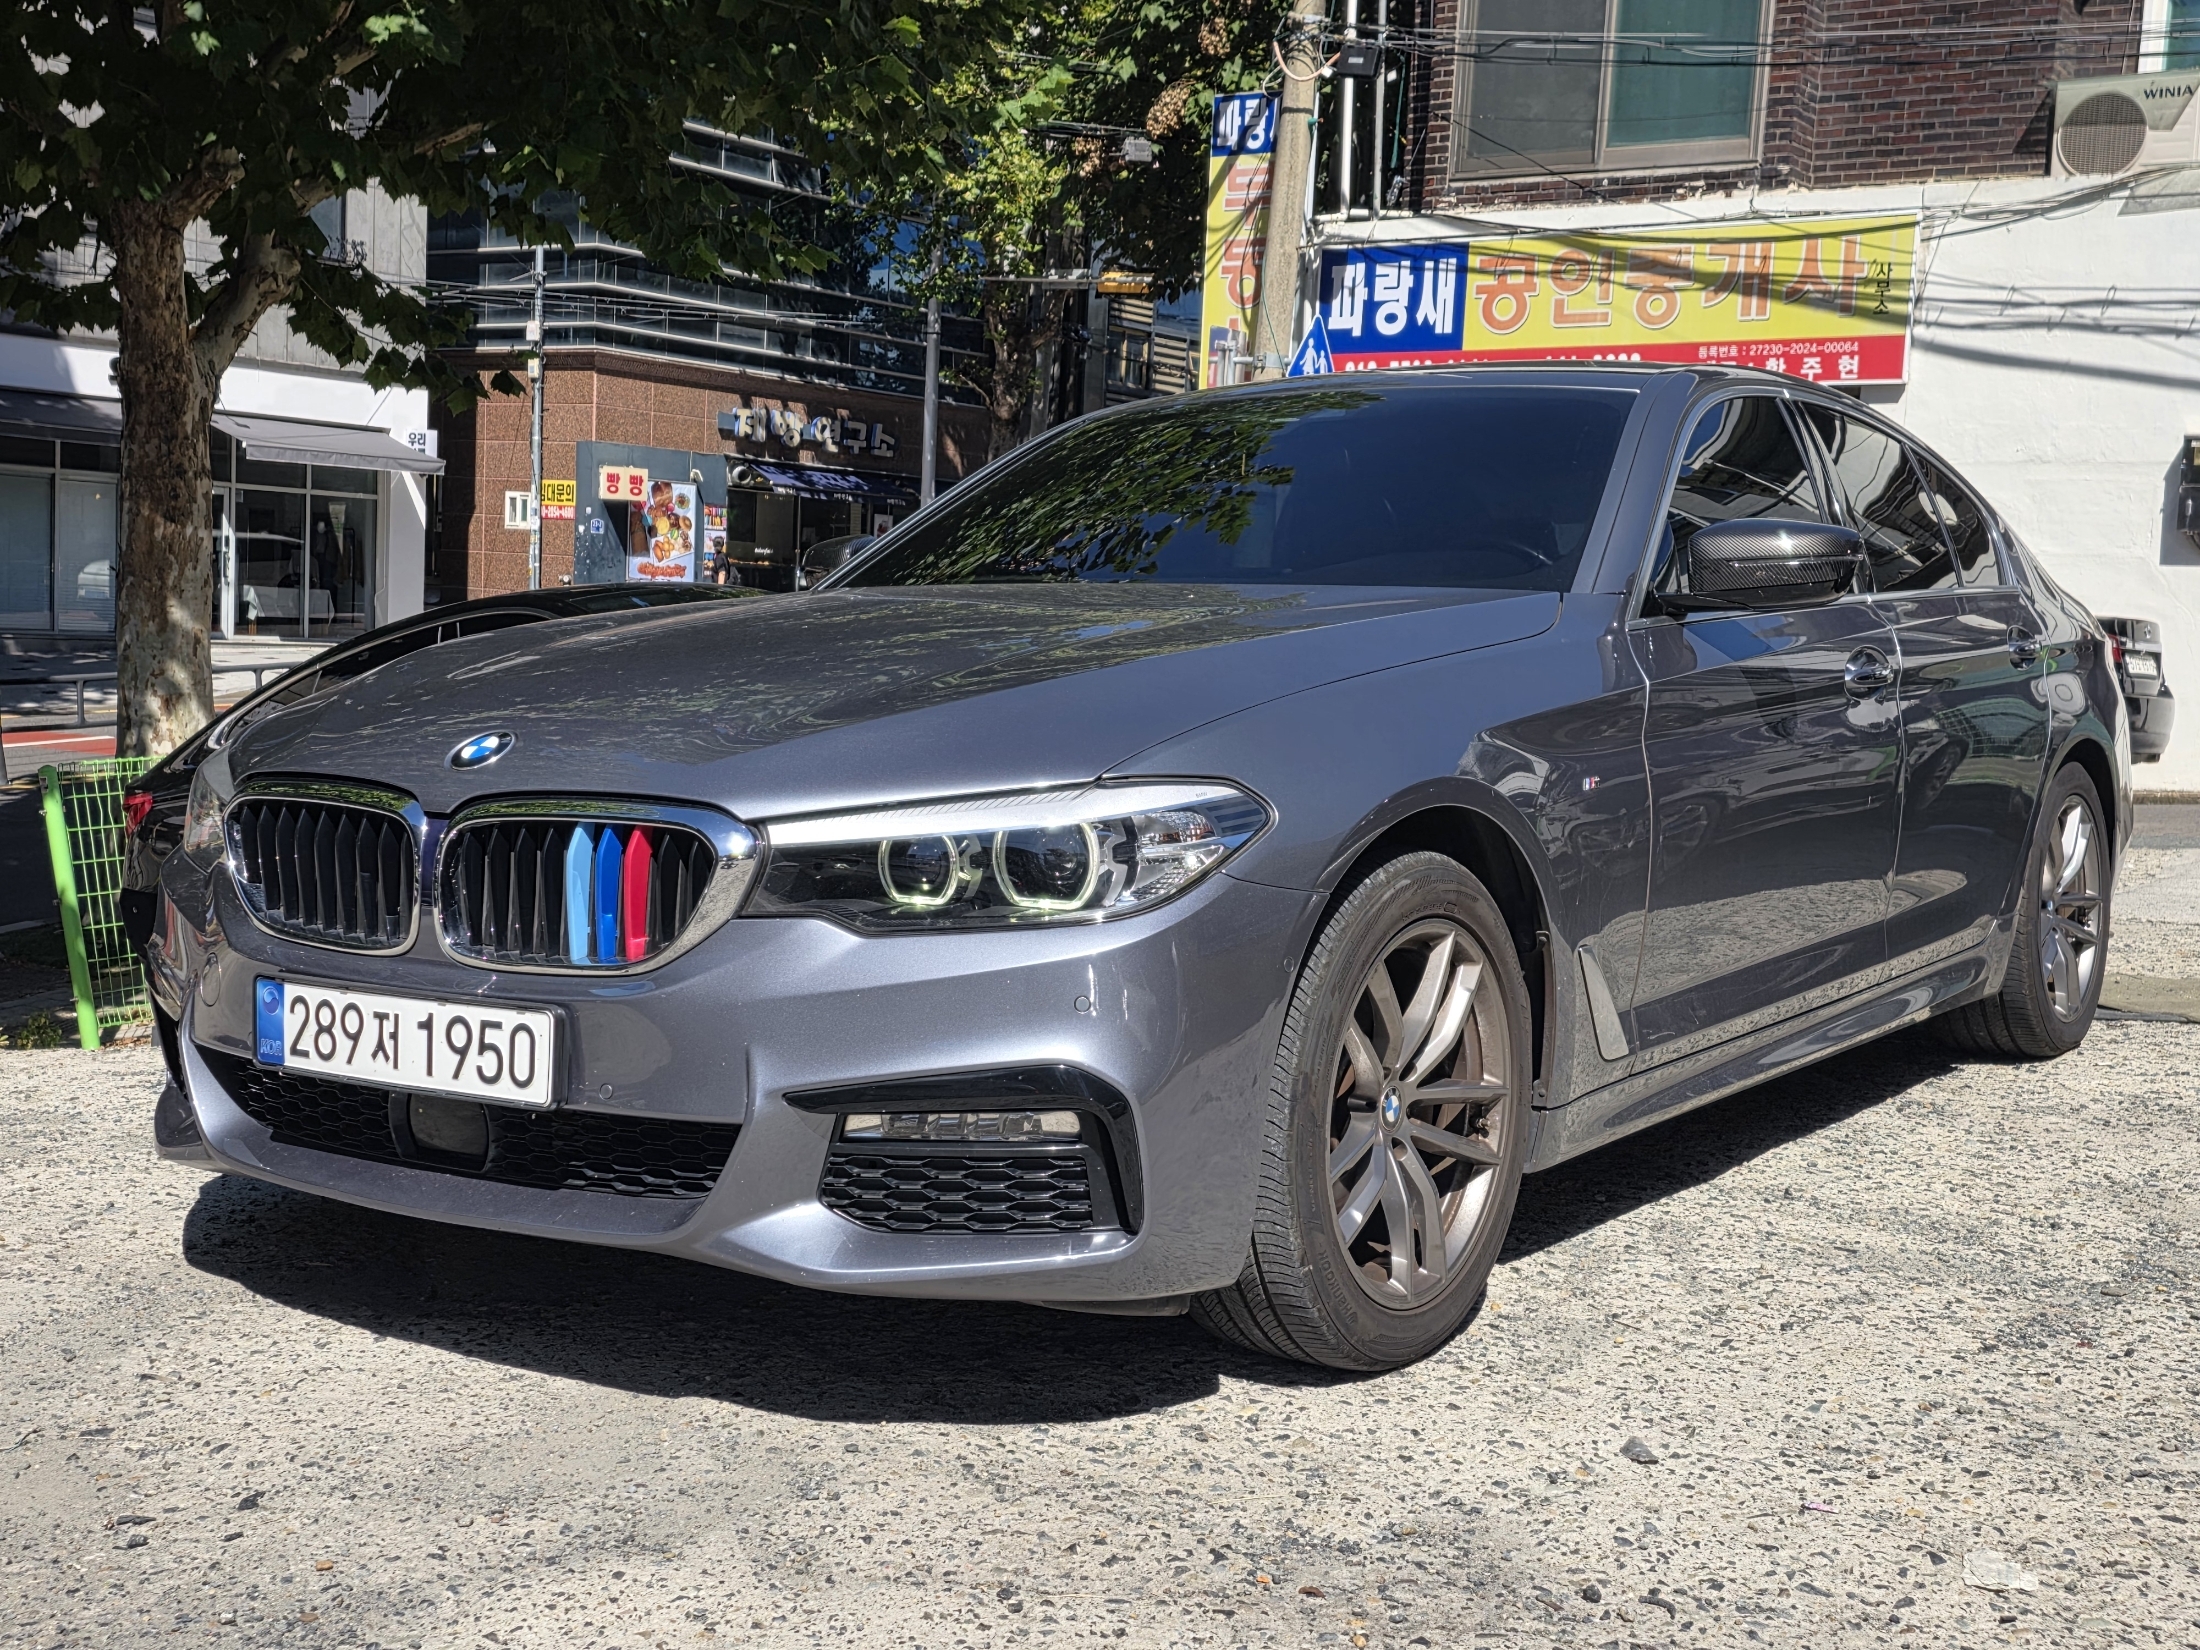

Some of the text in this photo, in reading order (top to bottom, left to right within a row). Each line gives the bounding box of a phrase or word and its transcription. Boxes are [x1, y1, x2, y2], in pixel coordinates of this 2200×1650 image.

[2143, 84, 2194, 100] WINIA
[1328, 234, 1893, 337] 파랑새 공인중개사 사무소
[1698, 344, 1739, 359] 등록번호
[408, 432, 426, 447] 우리
[260, 1038, 283, 1056] KOR
[289, 995, 536, 1089] 289저 1950
